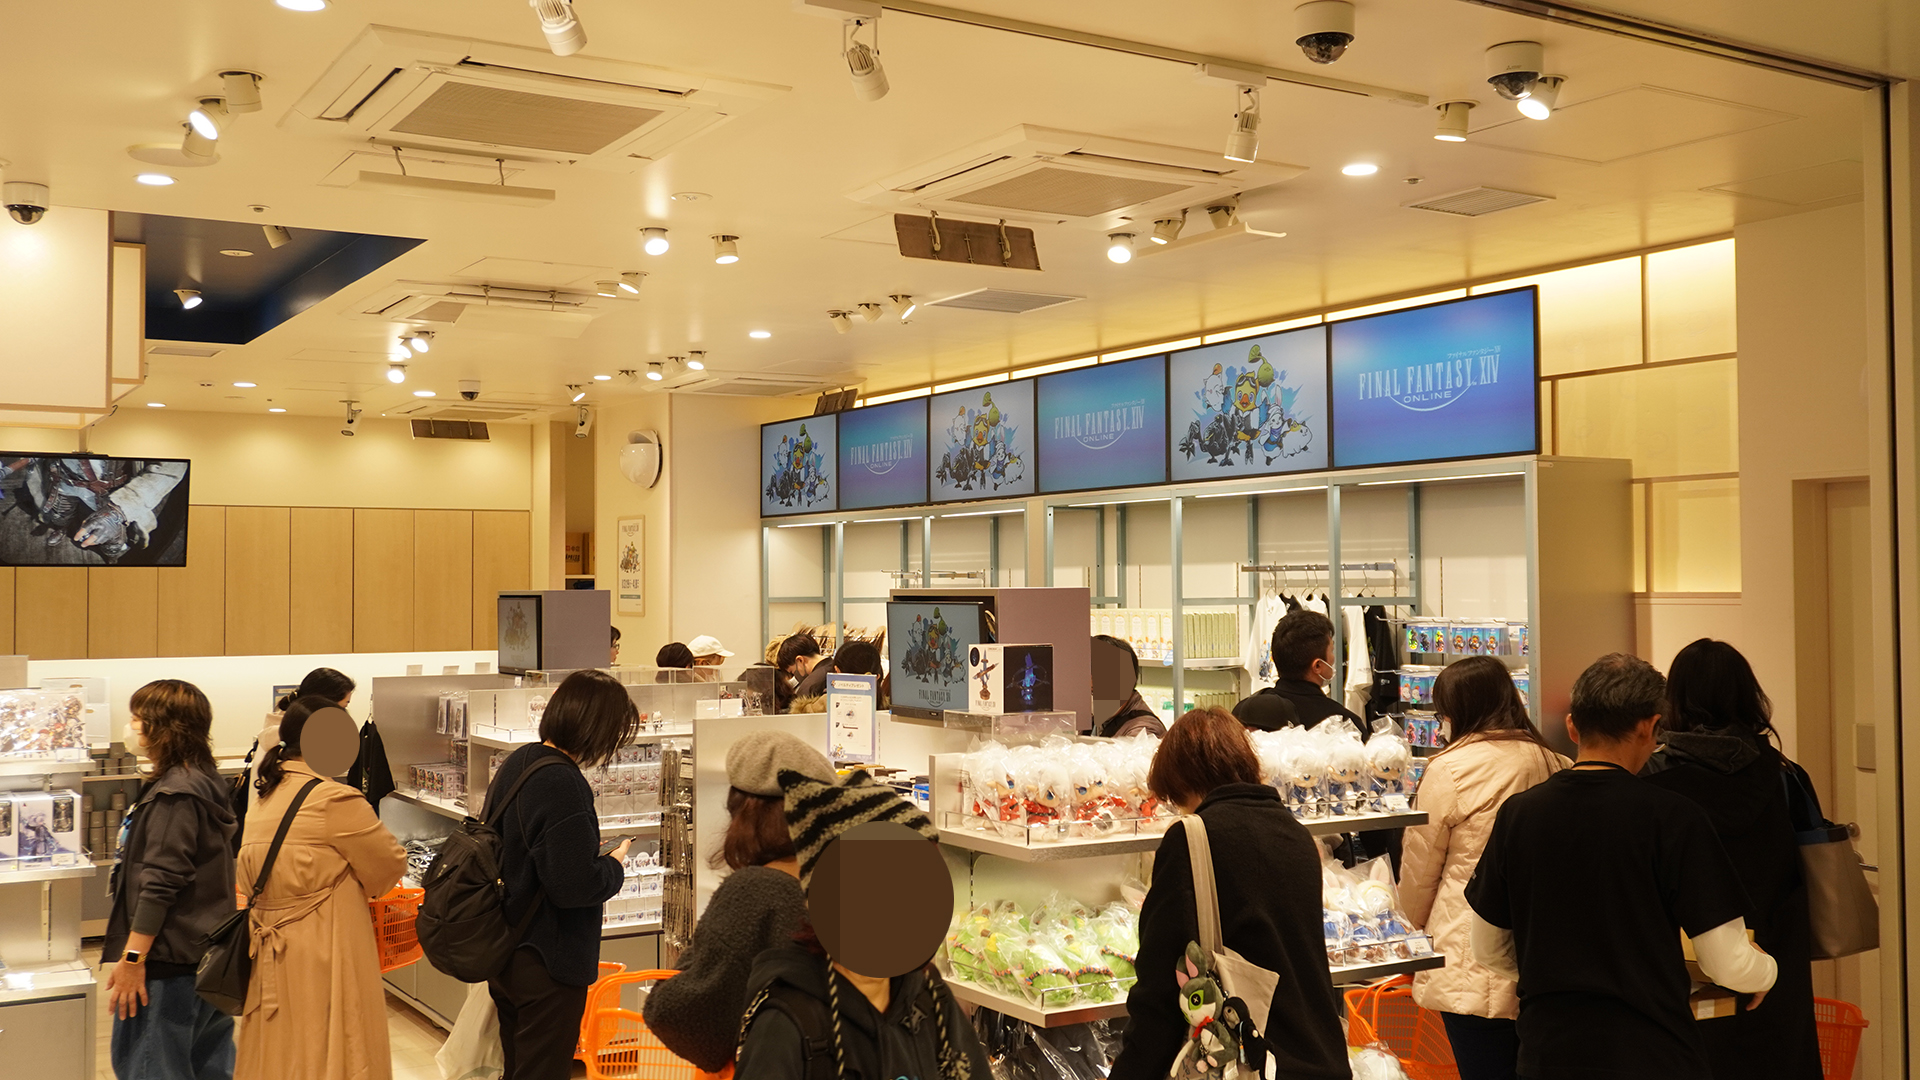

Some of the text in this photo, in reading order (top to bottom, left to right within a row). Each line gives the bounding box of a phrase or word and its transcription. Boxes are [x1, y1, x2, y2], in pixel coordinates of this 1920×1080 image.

[1359, 354, 1500, 400] FINAL FANTASY XIV
[1403, 391, 1452, 403] ONLINE
[1054, 405, 1145, 439] FINAL FANTASY XIV
[1083, 433, 1115, 443] ONLINE
[850, 445, 870, 466] FINAL
[869, 461, 893, 469] ONLINE
